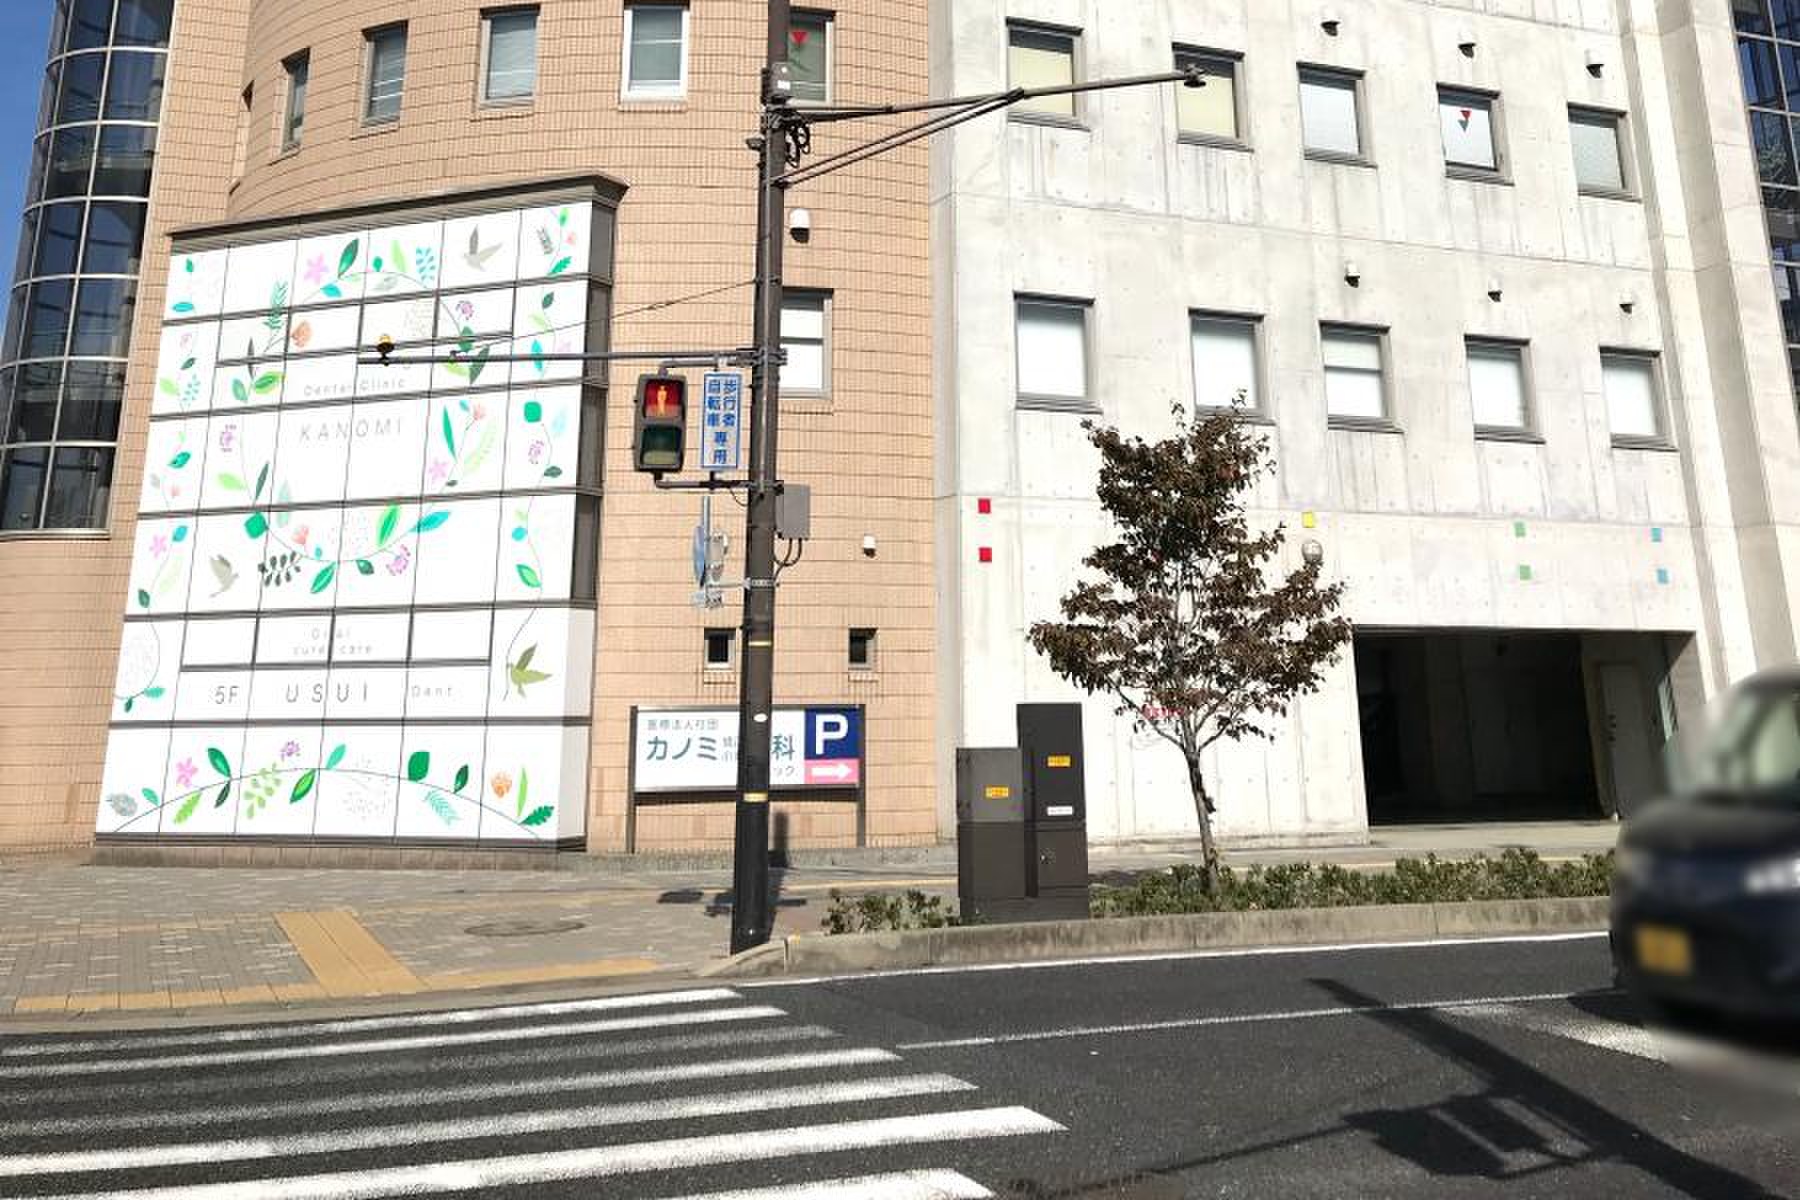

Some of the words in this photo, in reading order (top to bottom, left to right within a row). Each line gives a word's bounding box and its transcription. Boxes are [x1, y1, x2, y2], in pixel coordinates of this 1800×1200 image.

[300, 417, 402, 443] KANOMI
[214, 684, 240, 705] 5F
[285, 682, 369, 703] USUI
[815, 712, 849, 755] P
[646, 735, 718, 761] カノミ
